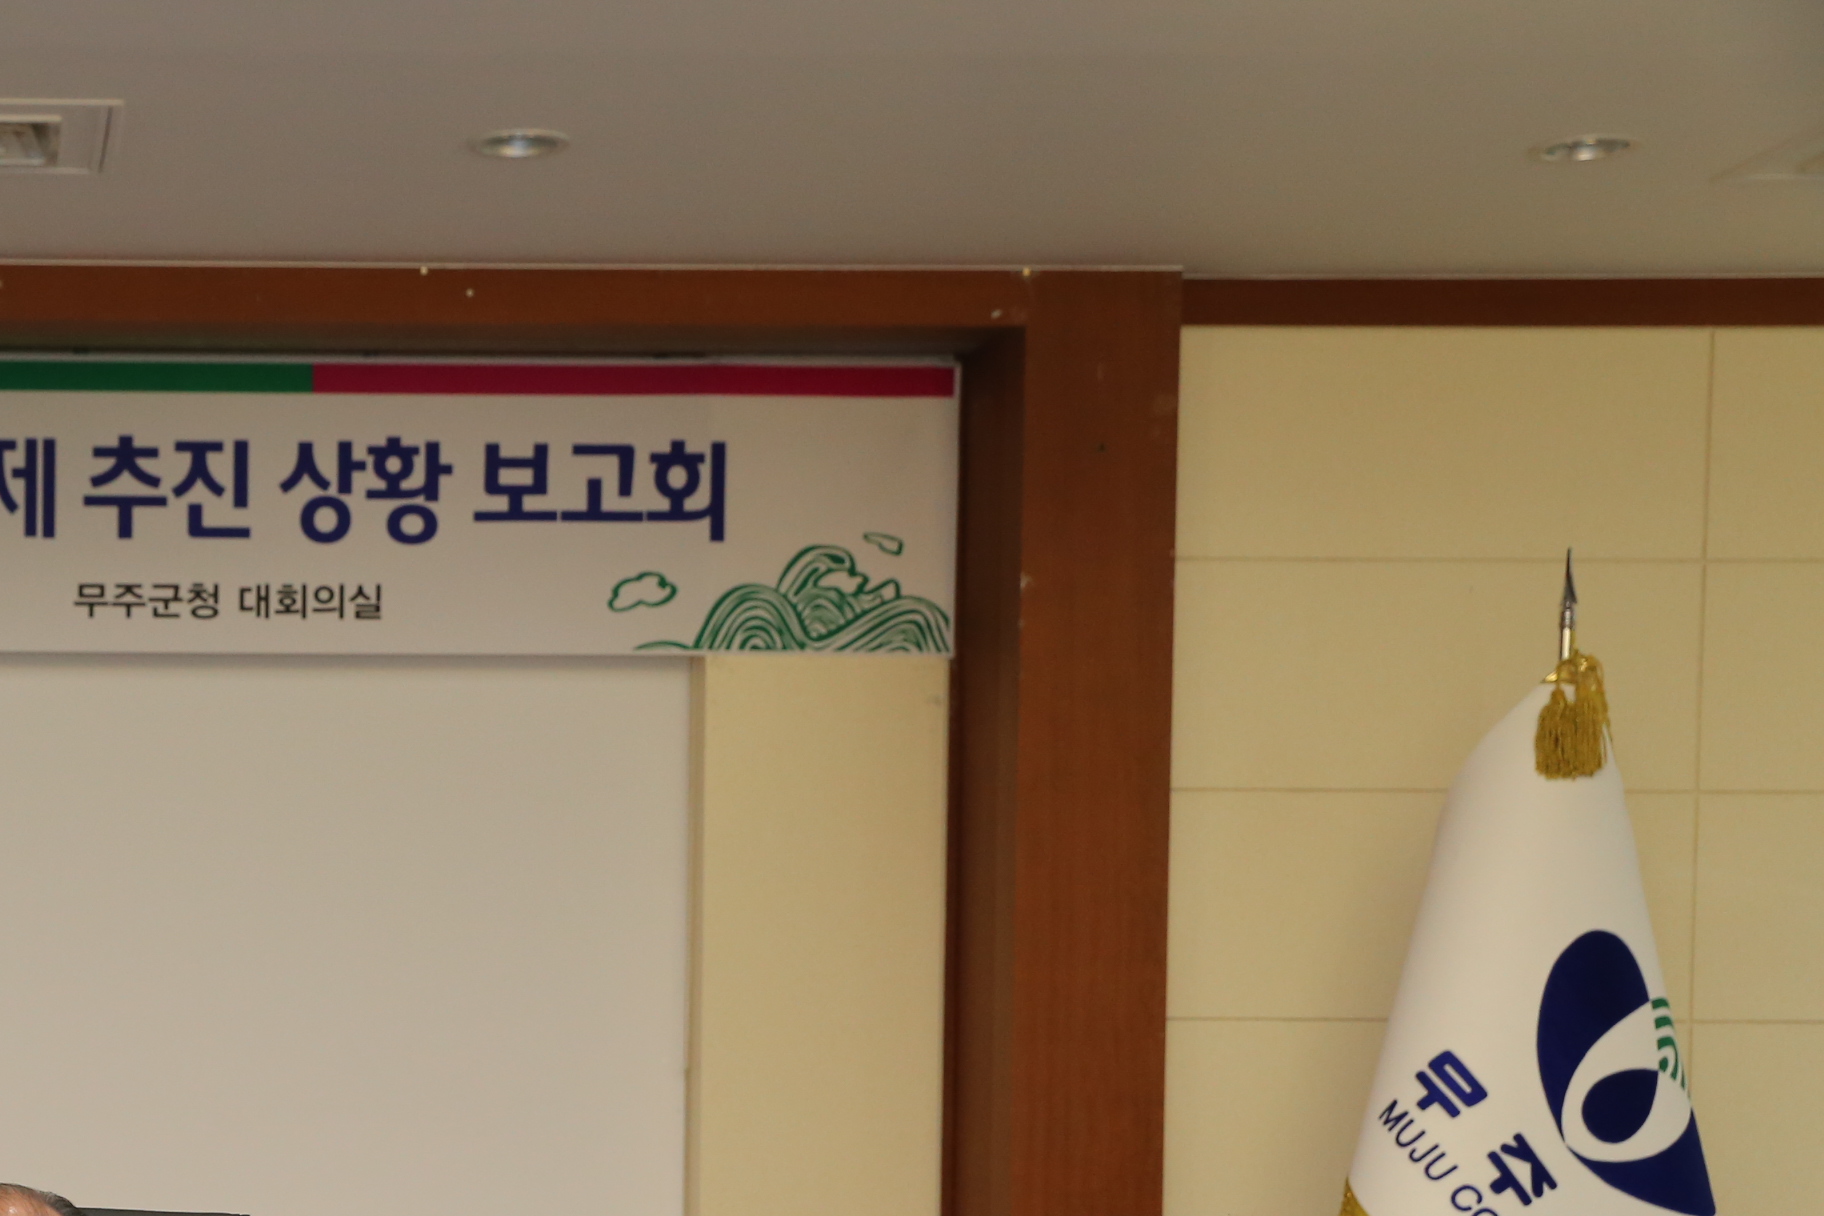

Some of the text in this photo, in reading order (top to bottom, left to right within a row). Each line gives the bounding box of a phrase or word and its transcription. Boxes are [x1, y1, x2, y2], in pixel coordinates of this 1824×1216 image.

[82, 434, 252, 540] 추진
[278, 435, 454, 546] 상황
[472, 438, 728, 543] 보고회
[73, 582, 383, 621] 무주군청 대회의실
[1379, 1098, 1459, 1182] MUJU
